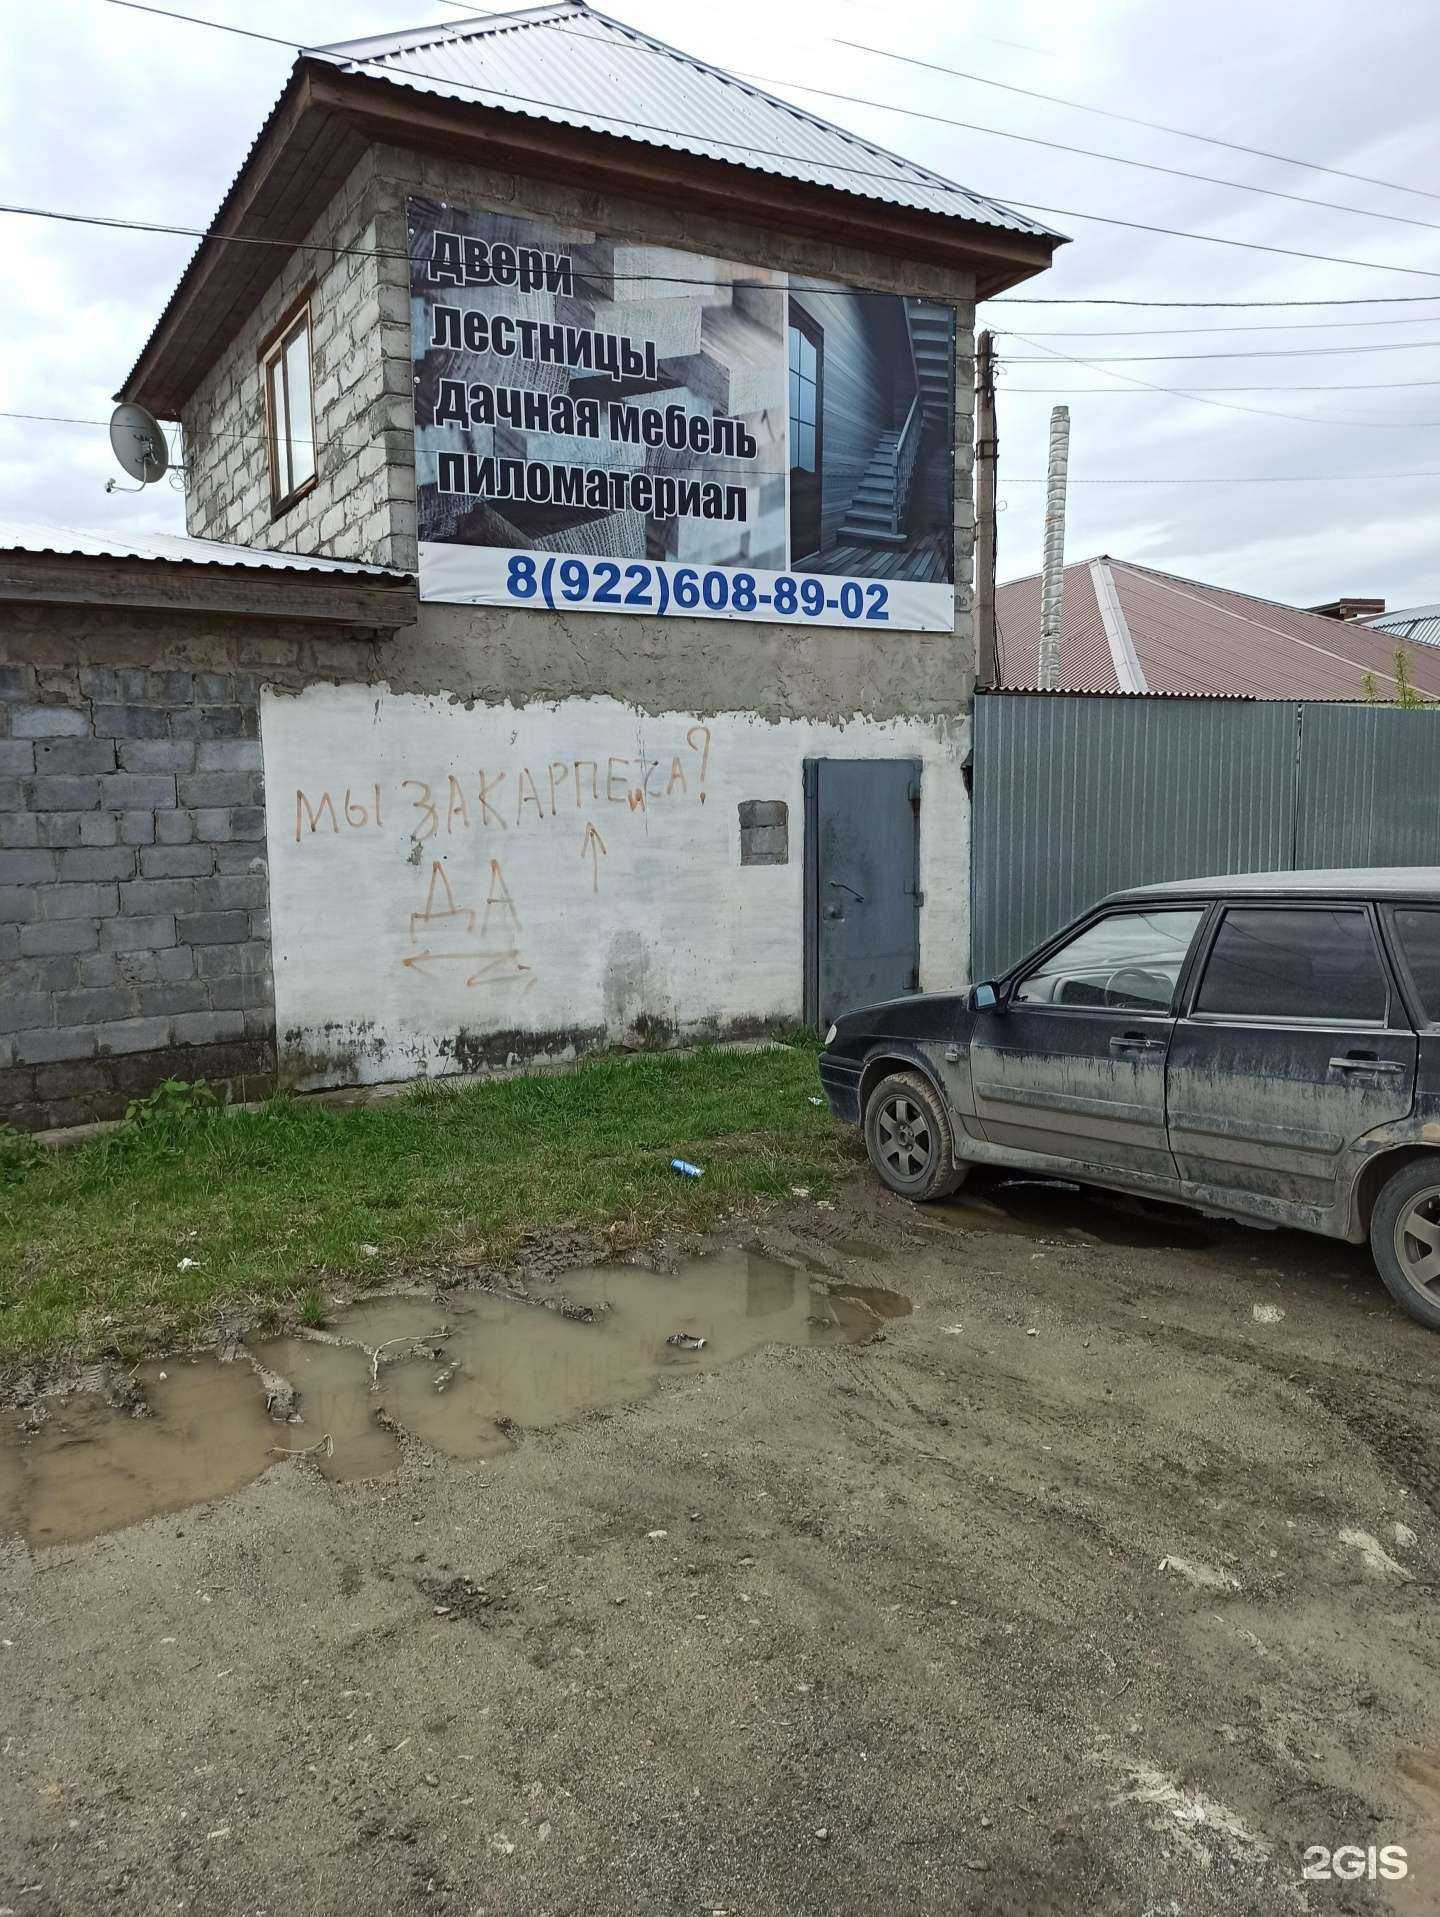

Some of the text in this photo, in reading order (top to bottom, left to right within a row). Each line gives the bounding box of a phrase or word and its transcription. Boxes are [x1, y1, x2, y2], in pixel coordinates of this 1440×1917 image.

[428, 230, 573, 298] двери
[431, 304, 657, 381] лестницы
[434, 379, 758, 460] дачная мебель
[437, 451, 748, 522] пиломатериал
[506, 555, 890, 621] 8(922)608-89-02
[409, 858, 522, 944] ДА
